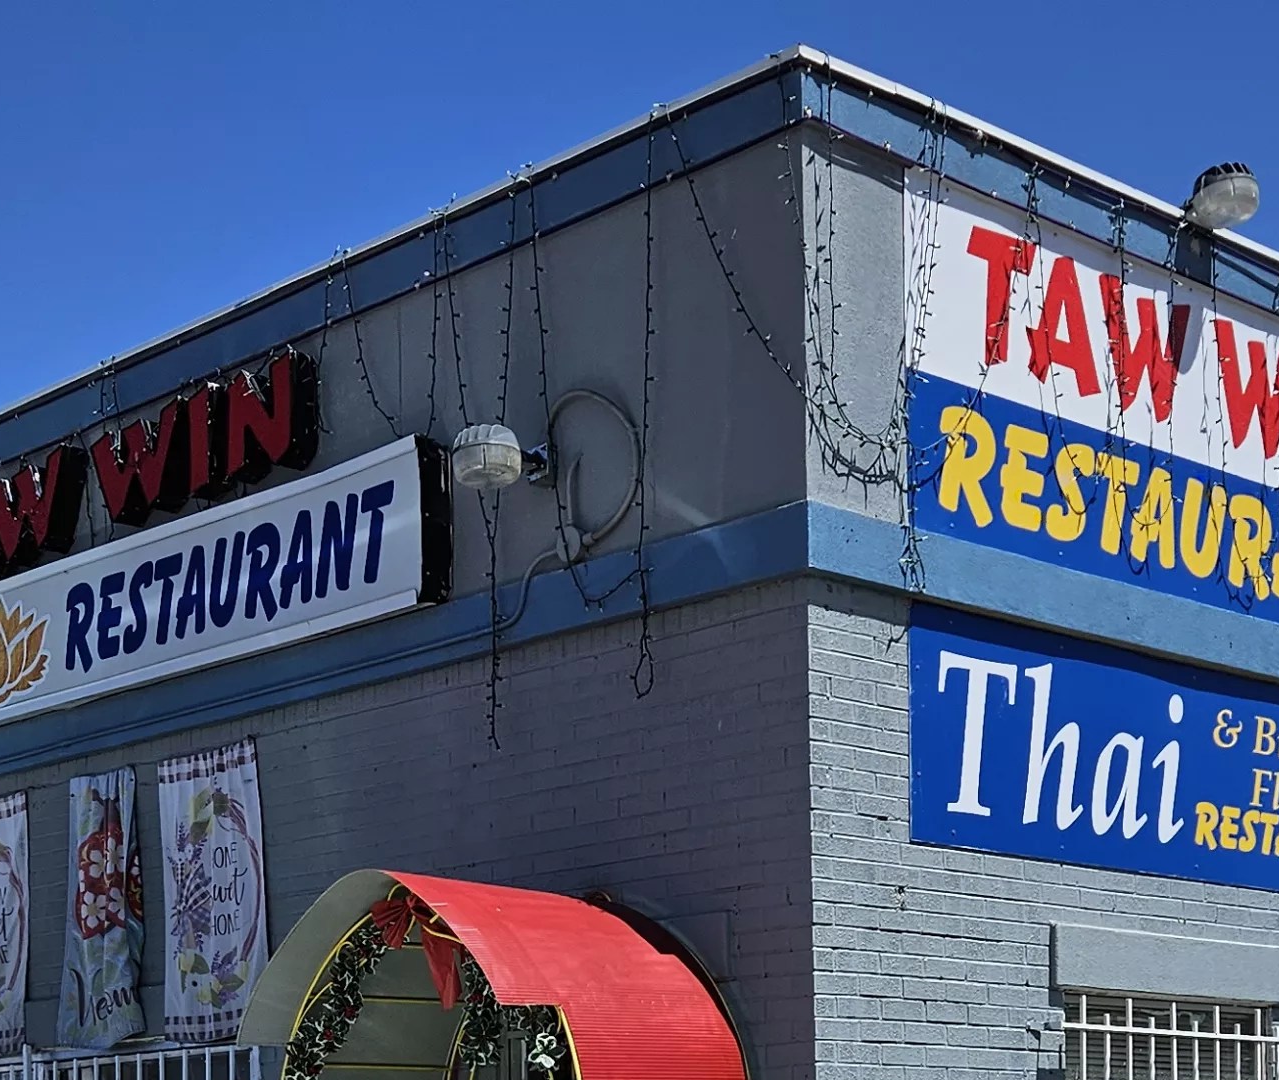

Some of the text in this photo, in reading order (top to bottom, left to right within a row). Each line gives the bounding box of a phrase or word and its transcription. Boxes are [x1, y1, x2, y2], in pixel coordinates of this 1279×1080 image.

[967, 225, 1190, 422] TAW
[91, 354, 295, 519] WIN
[65, 480, 395, 672] RESTAURANT
[938, 650, 1184, 844] Thai
[1212, 709, 1243, 748] &
